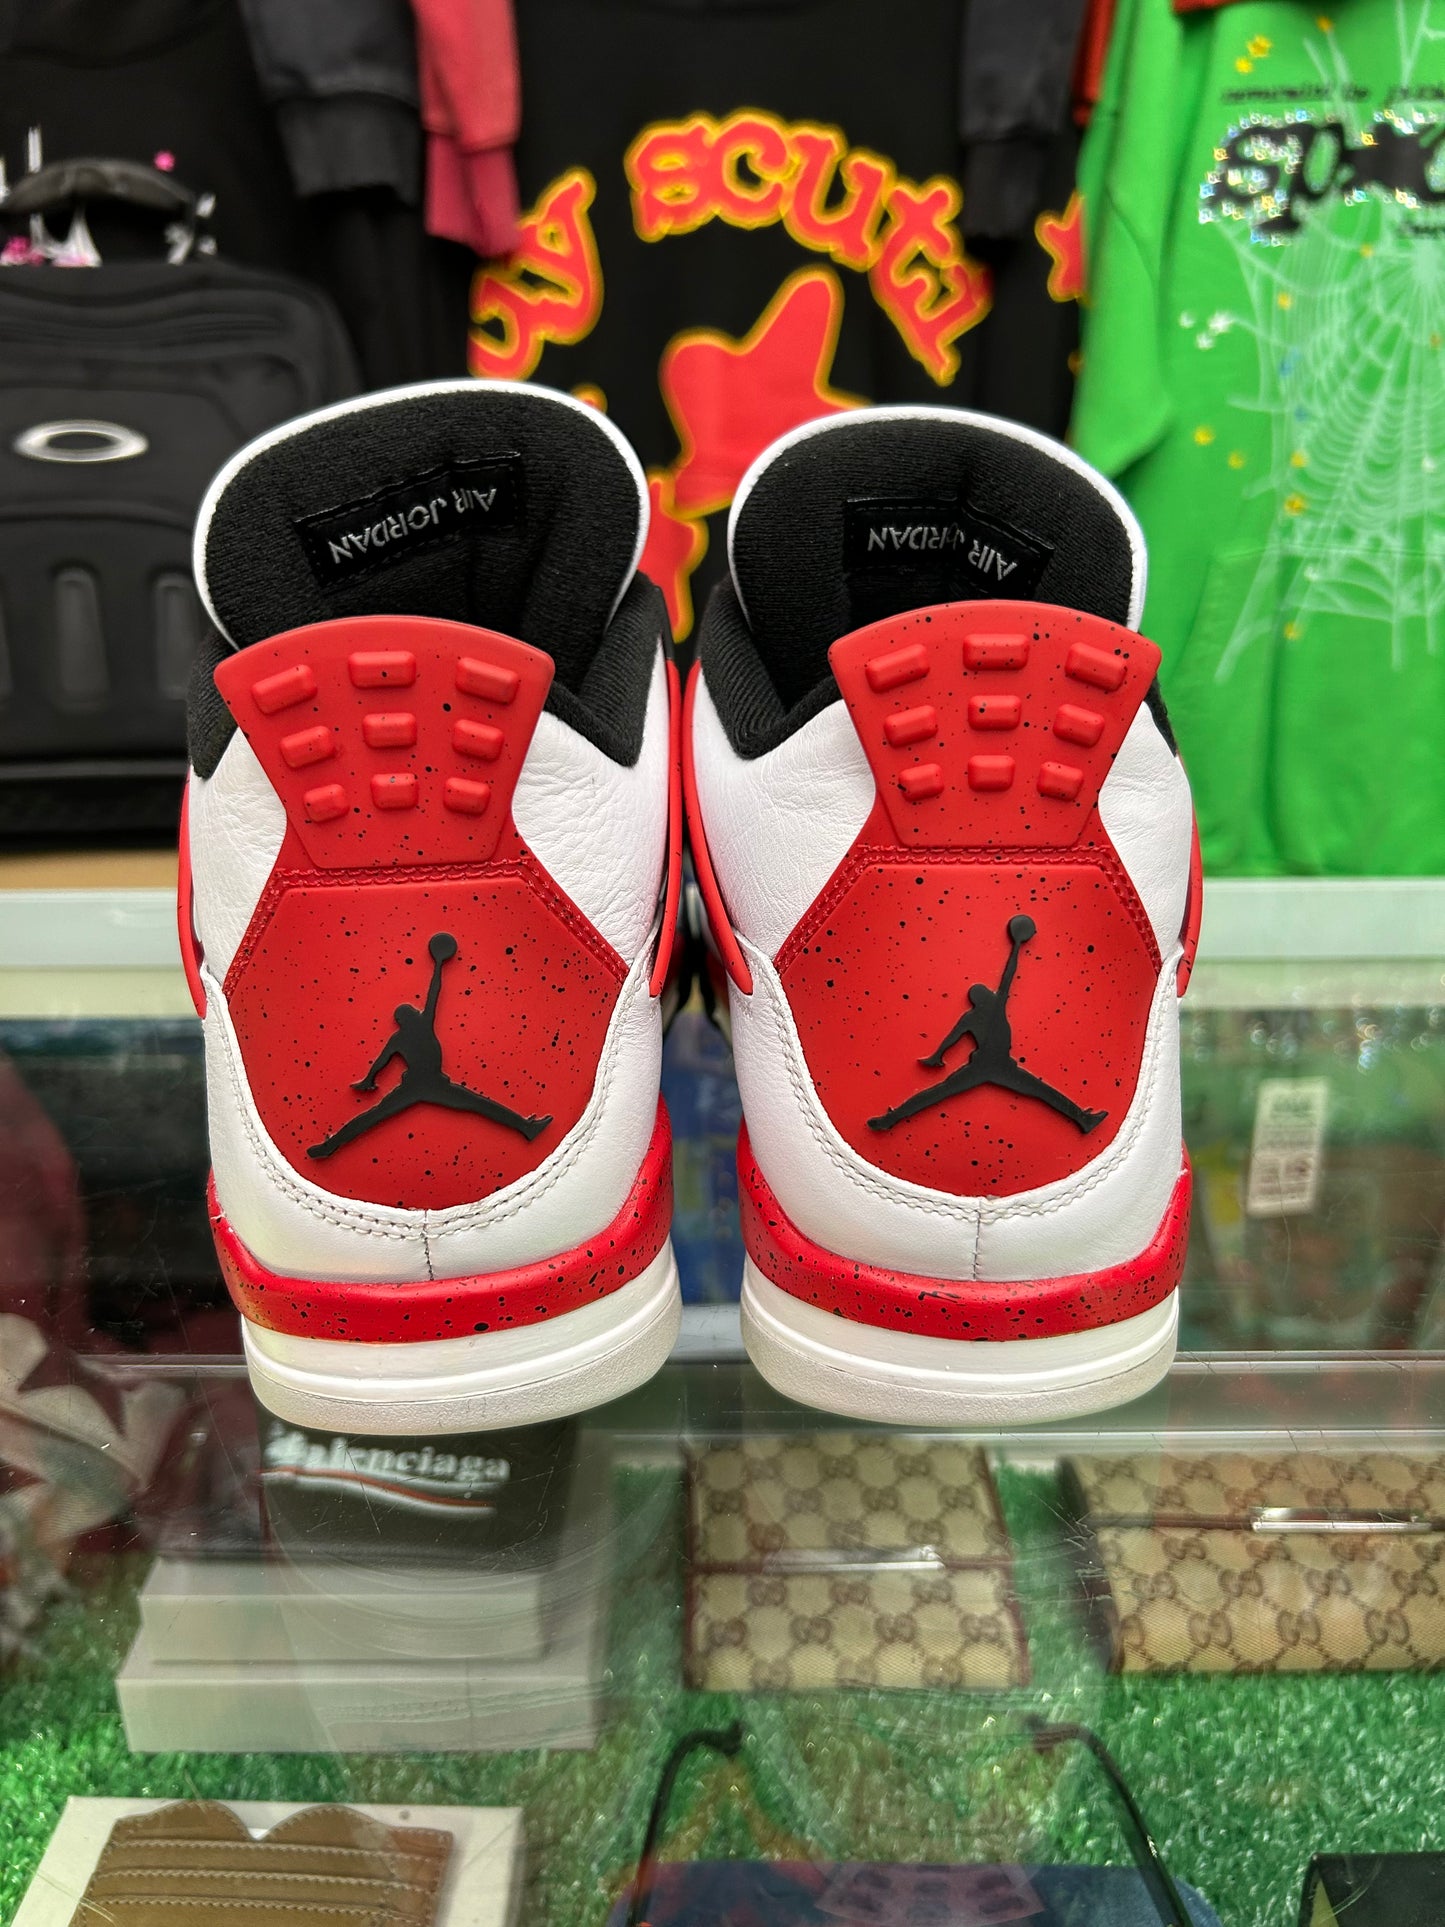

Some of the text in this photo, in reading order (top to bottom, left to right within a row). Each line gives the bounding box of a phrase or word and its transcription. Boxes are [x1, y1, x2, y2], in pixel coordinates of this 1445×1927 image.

[327, 487, 498, 565] AIR JORDAN
[967, 538, 1019, 582] AIR
